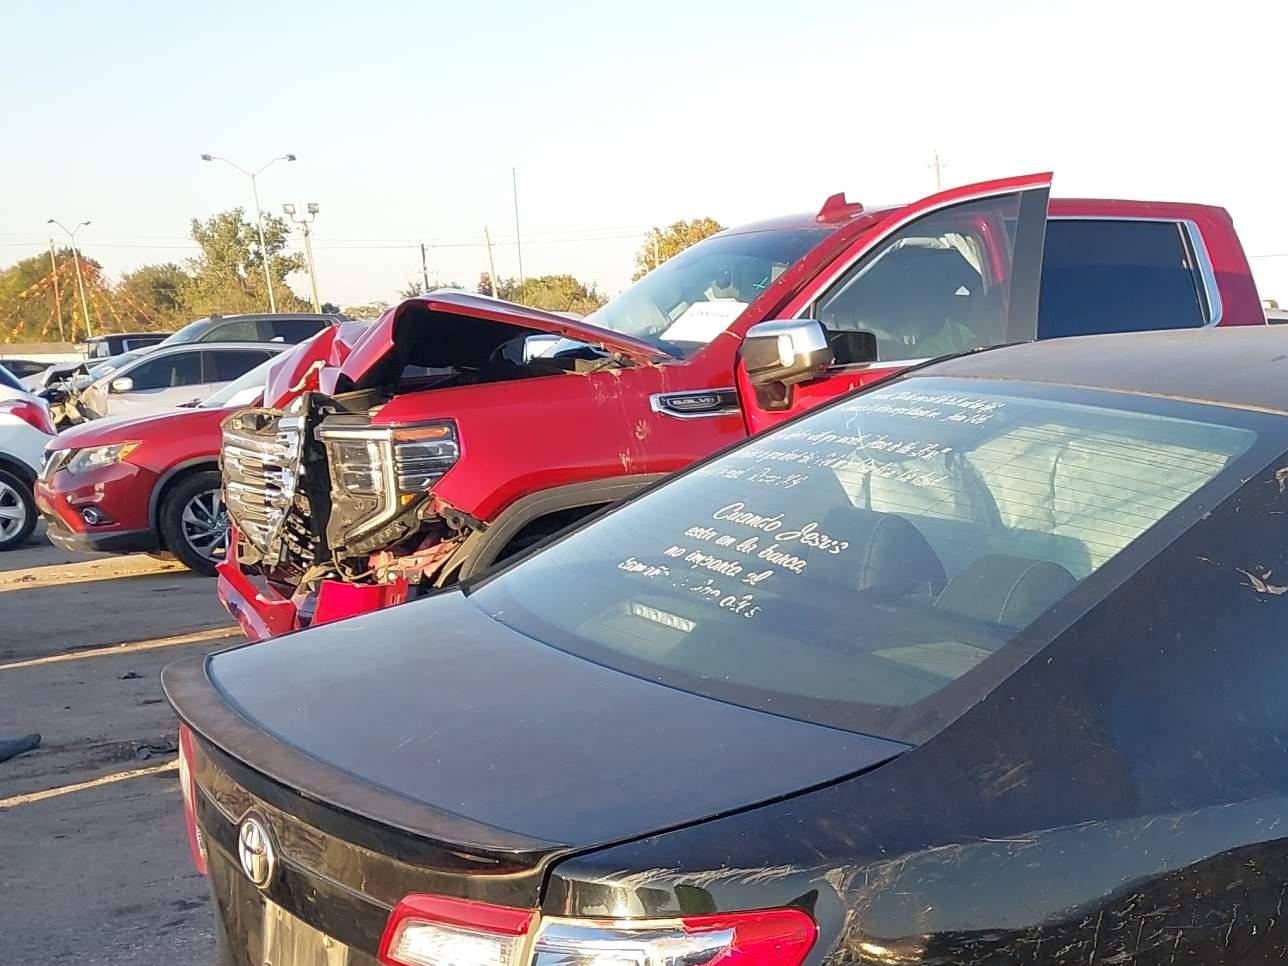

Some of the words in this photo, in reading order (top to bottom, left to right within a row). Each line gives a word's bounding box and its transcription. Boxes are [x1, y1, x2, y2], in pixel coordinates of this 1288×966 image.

[713, 502, 785, 532] Cuando
[715, 535, 737, 547] en
[736, 536, 759, 553] la
[663, 545, 686, 558] no
[742, 570, 775, 585] el
